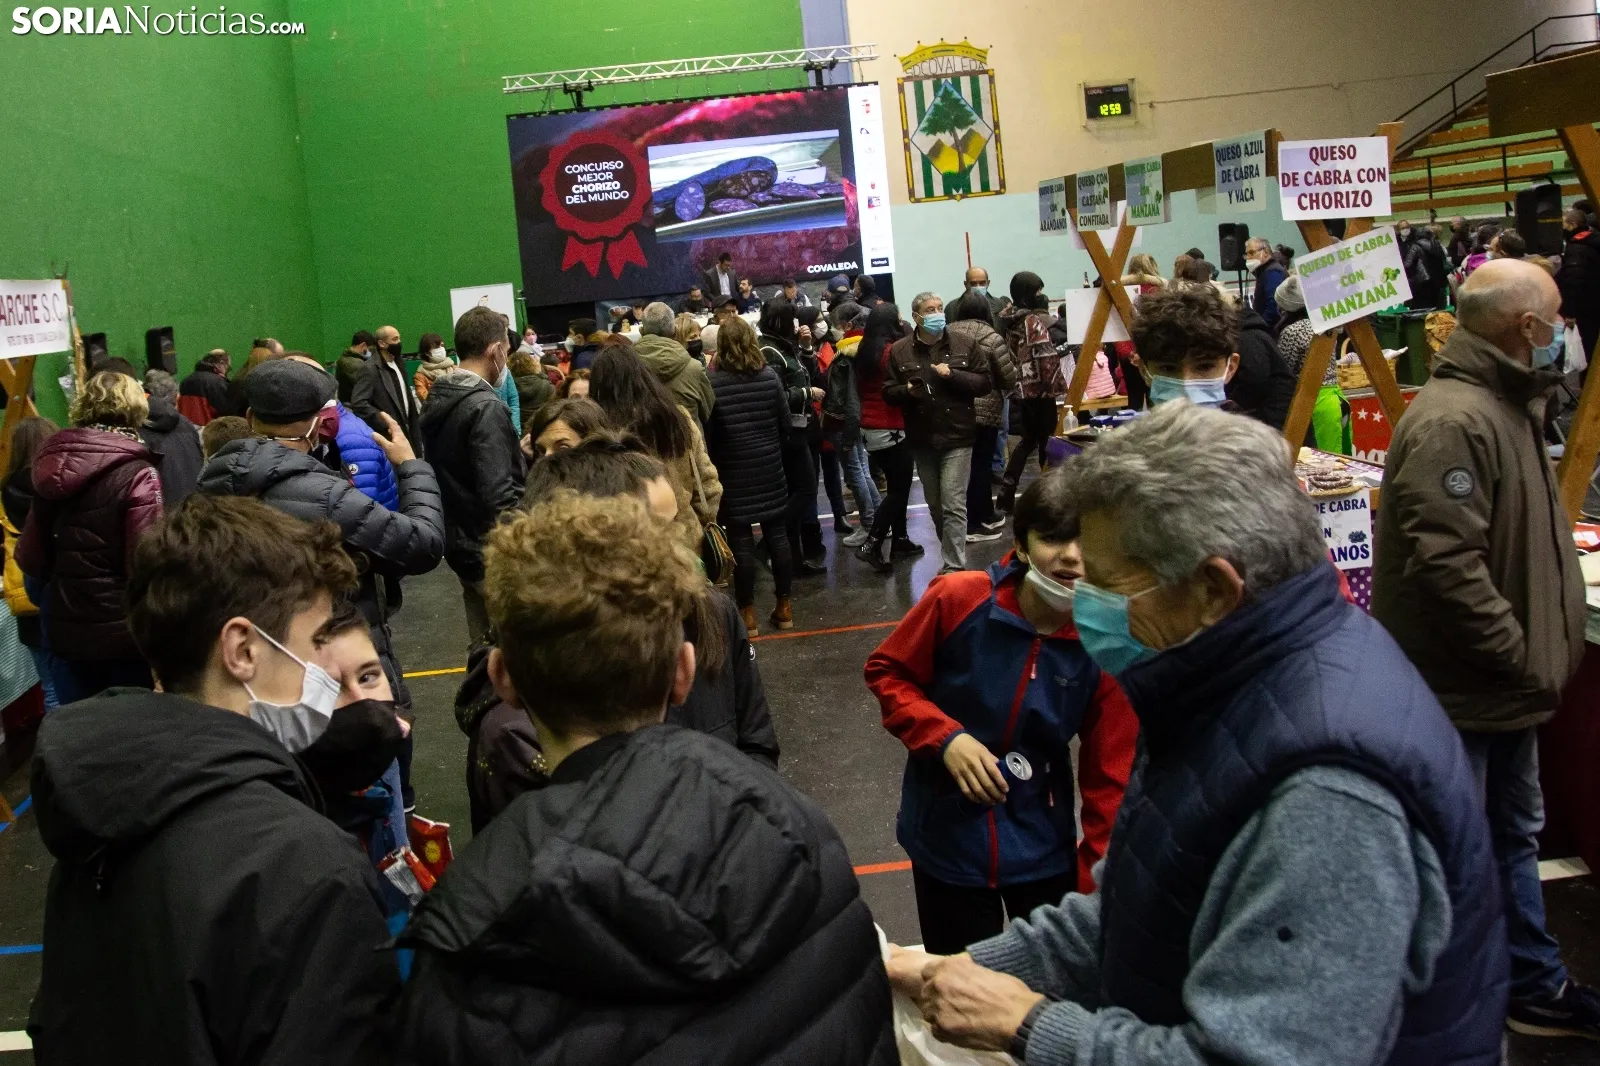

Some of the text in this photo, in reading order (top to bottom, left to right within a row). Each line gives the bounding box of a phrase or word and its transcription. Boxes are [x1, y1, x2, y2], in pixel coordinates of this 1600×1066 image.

[1216, 140, 1264, 166] QUESO AZUL
[1309, 144, 1357, 166] QUESO
[565, 160, 624, 174] CONCURSO
[1221, 164, 1260, 183] DE CABRA
[577, 171, 613, 182] MEJOR
[1096, 173, 1108, 184] CON
[1281, 167, 1387, 187] DE CABRA CON
[572, 181, 621, 193] CHORIZO
[1228, 187, 1255, 205] Y VACA
[566, 191, 629, 204] DEL MUNDO
[1297, 189, 1373, 211] CHORIZO
[1079, 214, 1109, 227] CONFITADA
[1299, 232, 1393, 278] QUESO DE CABRA
[807, 261, 858, 273] COVALEDA
[1340, 269, 1365, 288] CON
[1320, 281, 1398, 322] MANZANA
[1329, 498, 1367, 513] CABRA
